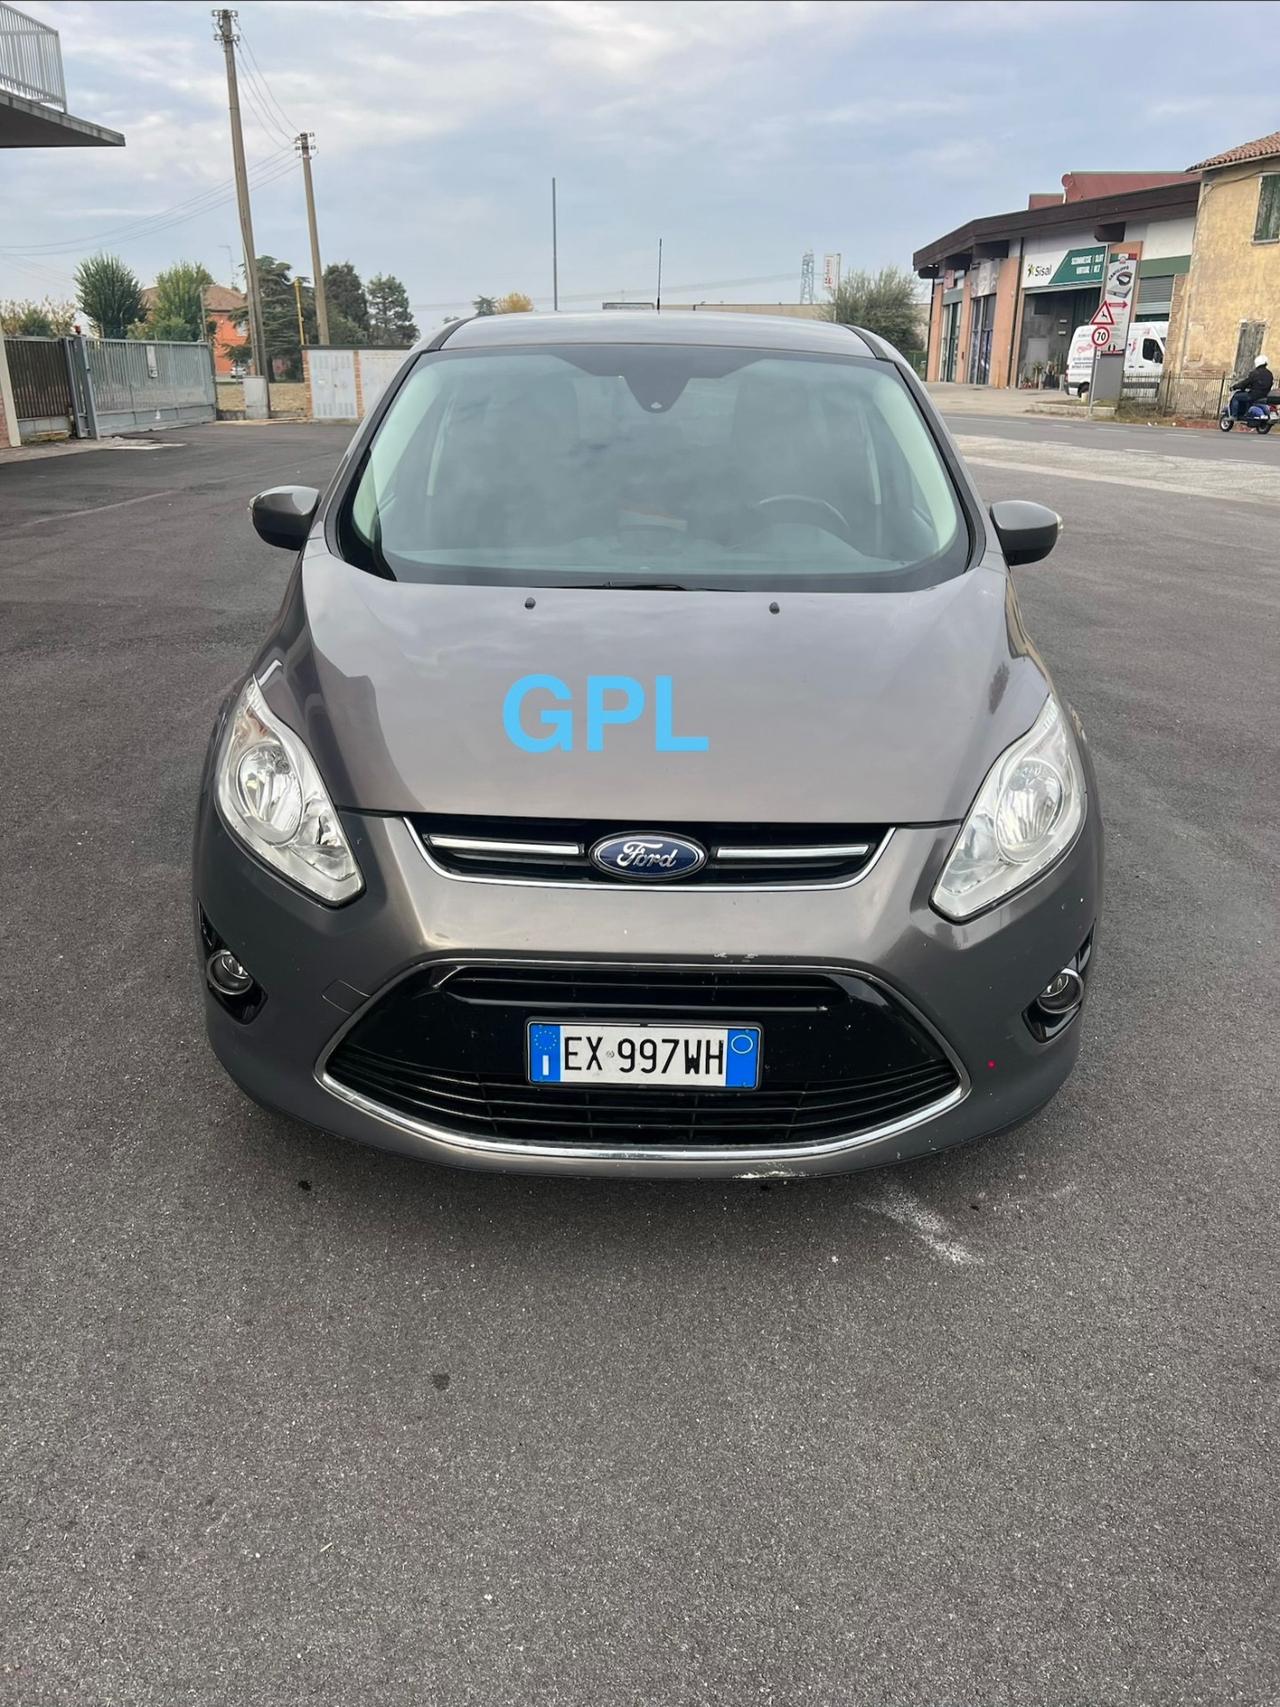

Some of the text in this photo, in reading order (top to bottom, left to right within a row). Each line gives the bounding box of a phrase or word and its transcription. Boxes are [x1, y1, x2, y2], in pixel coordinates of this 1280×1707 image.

[1035, 264, 1053, 277] Sisal
[1096, 331, 1107, 342] 70
[616, 841, 678, 867] Ford
